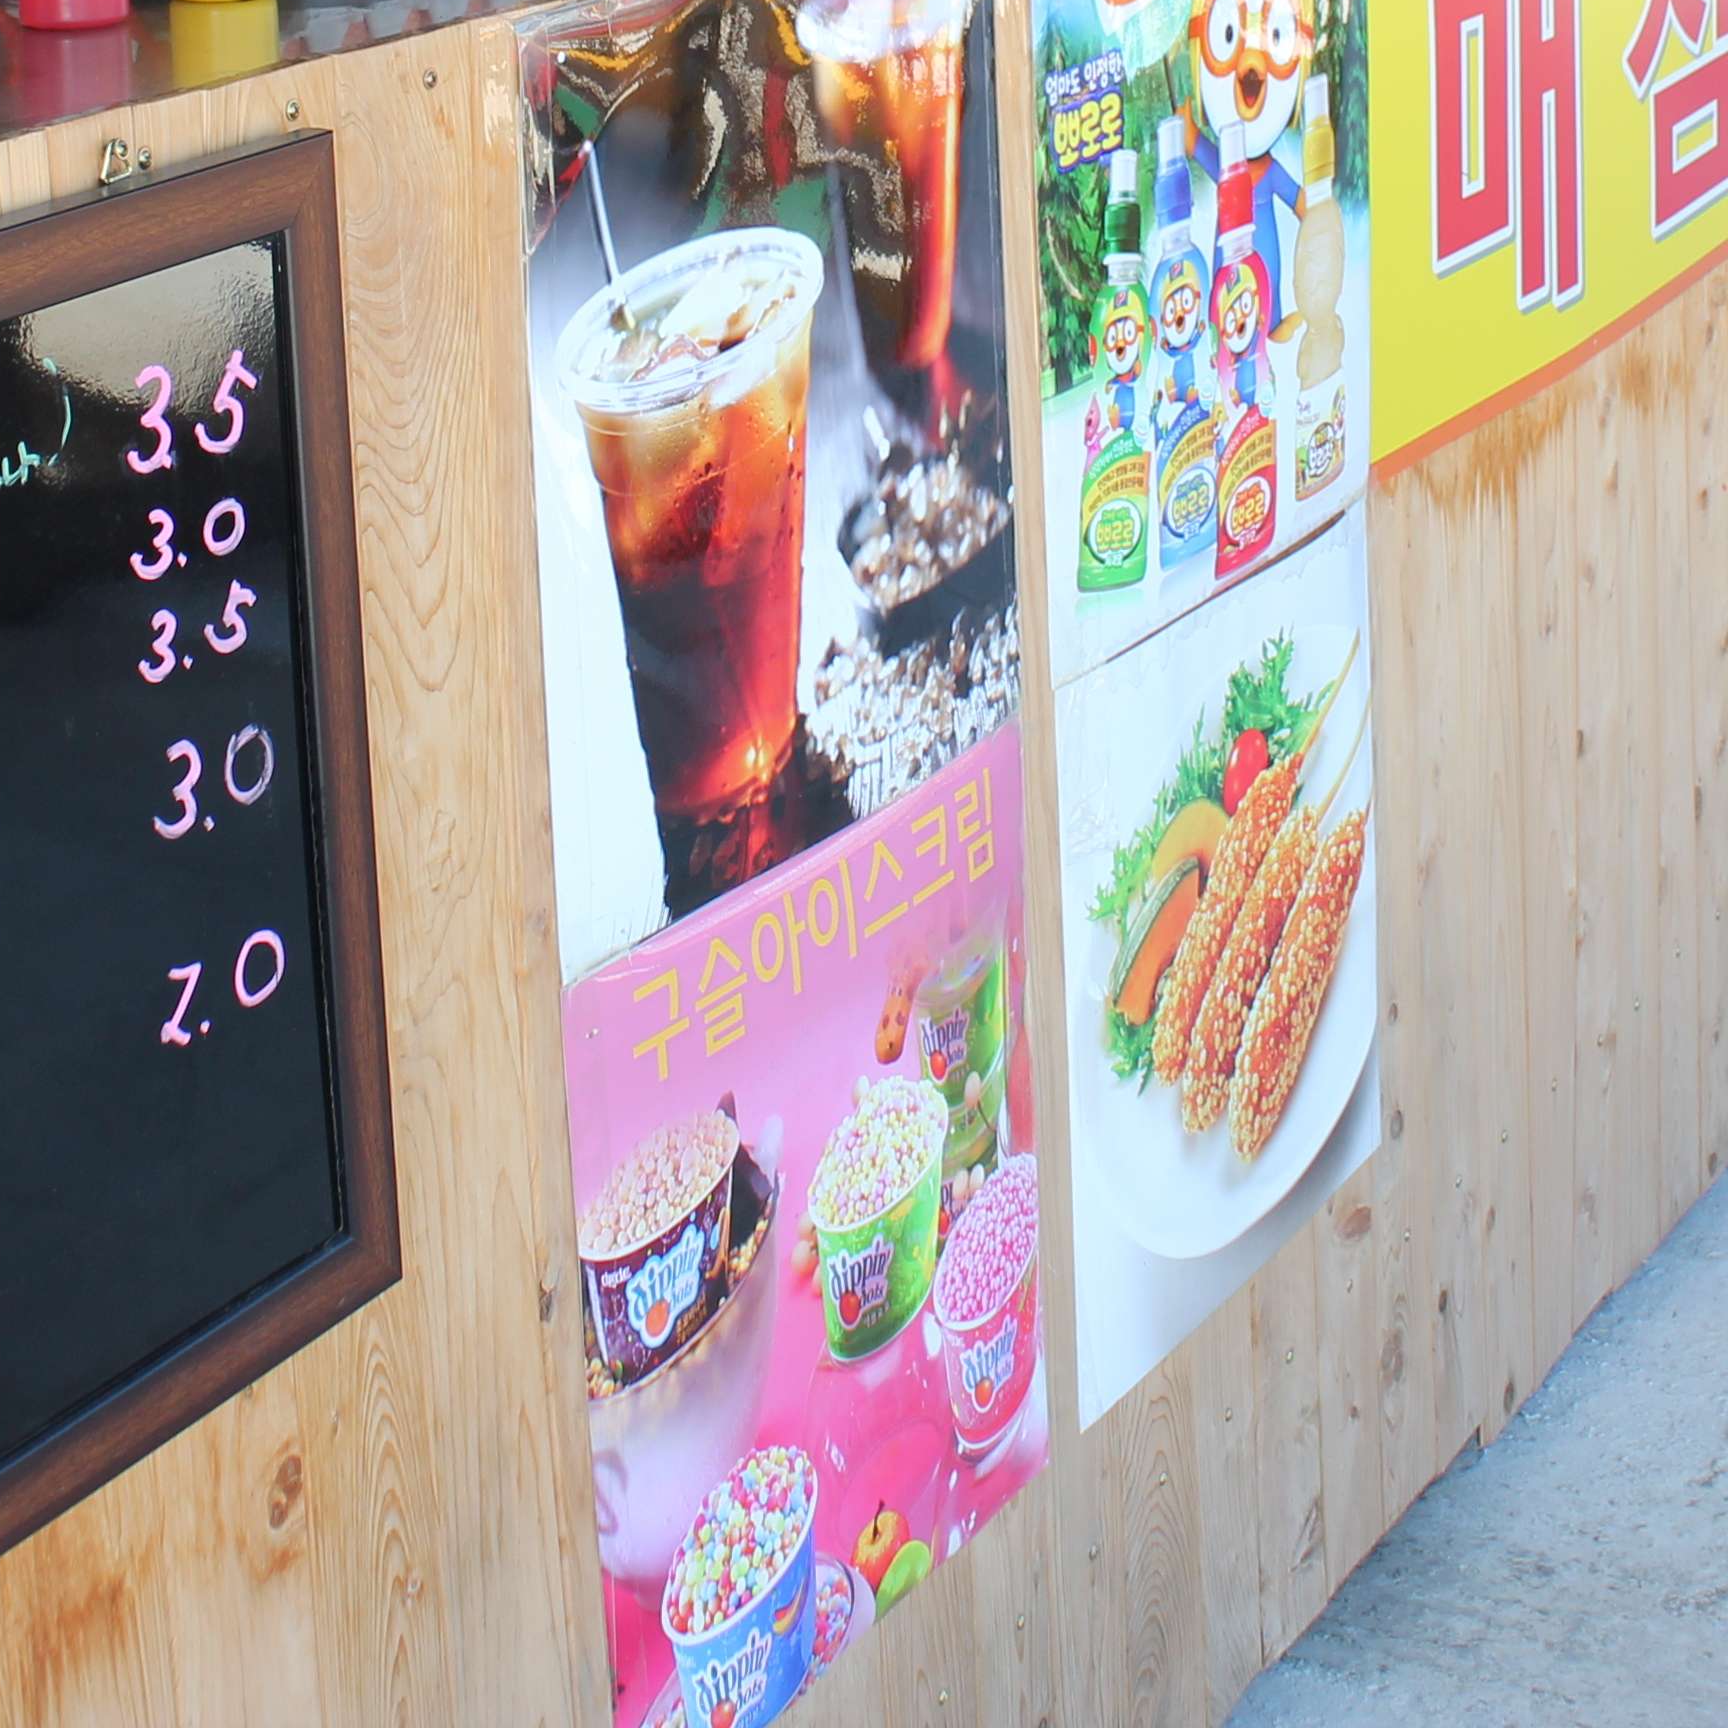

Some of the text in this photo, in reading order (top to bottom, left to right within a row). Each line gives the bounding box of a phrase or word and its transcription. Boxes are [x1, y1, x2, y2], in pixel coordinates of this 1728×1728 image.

[1044, 67, 1082, 107] 엄마도
[1053, 92, 1123, 169] 뽀로로
[127, 349, 258, 475] 3.5
[130, 498, 248, 582] 3.0
[137, 580, 257, 683] 3.5
[153, 723, 275, 840] 3.0
[633, 768, 996, 1081] 구슬아이스크림
